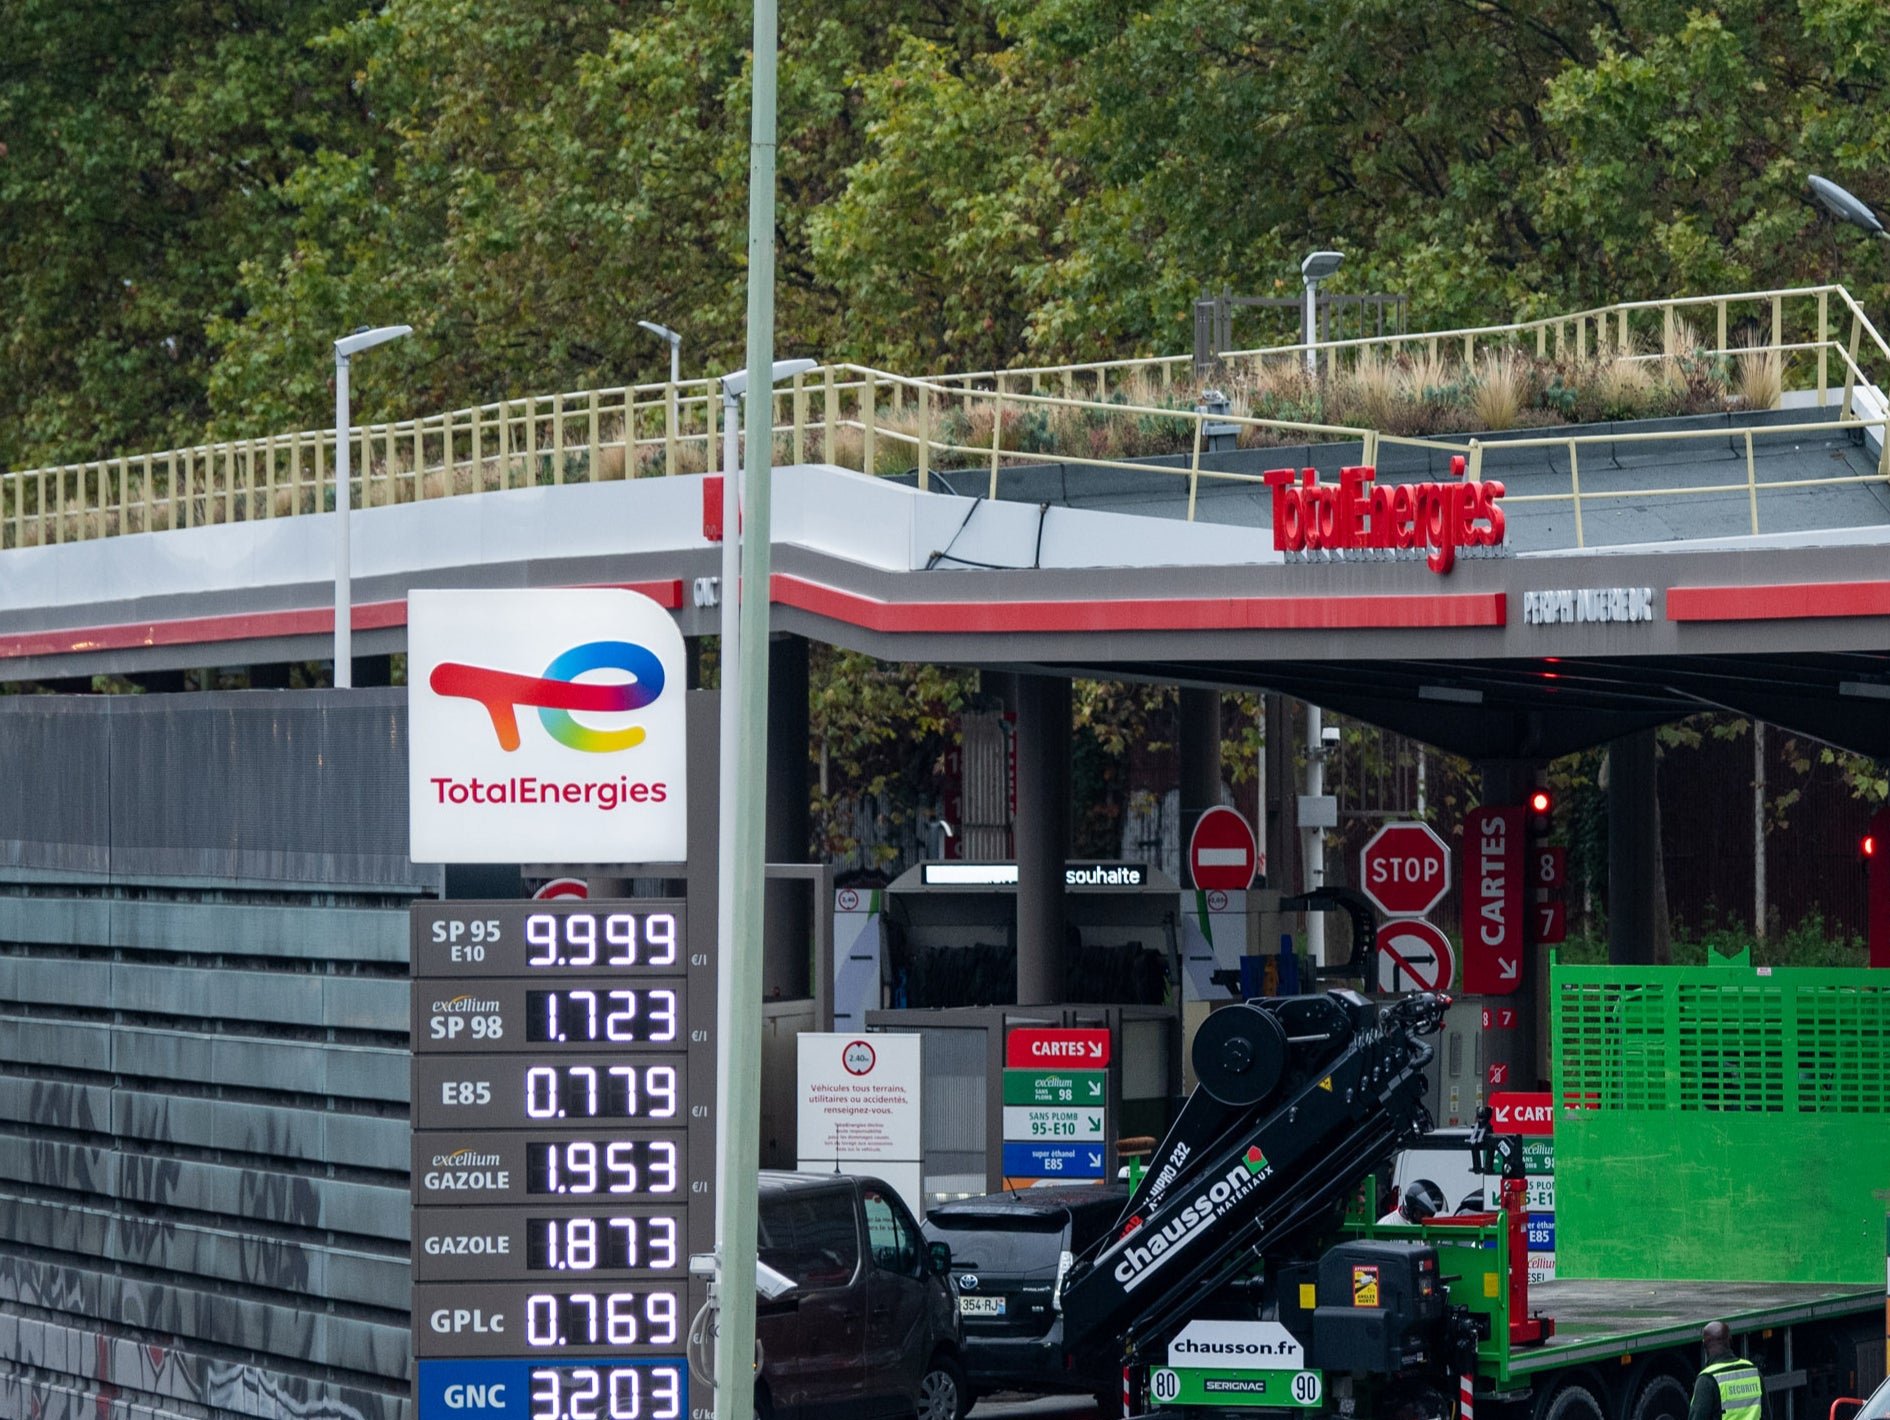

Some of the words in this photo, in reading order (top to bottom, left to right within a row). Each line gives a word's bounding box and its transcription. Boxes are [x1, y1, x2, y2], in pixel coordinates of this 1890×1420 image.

[1263, 455, 1506, 574] TotalEnergies
[430, 776, 667, 810] TotalEnergies
[1066, 866, 1141, 884] souhaite
[1372, 857, 1439, 883] STOP
[1540, 854, 1556, 882] 8
[1481, 816, 1506, 946] CARTES
[432, 920, 464, 943] SP
[470, 920, 501, 943] 95
[1540, 910, 1555, 937] 7
[526, 914, 676, 966] 9.999
[451, 946, 485, 962] E10
[432, 996, 500, 1012] excellium
[548, 990, 676, 1042] 1.723
[1482, 1012, 1489, 1026] 8
[1502, 1011, 1512, 1026] 7
[430, 1016, 465, 1039] SP
[471, 1016, 503, 1039] 98
[1032, 1041, 1085, 1056] CARTES
[526, 1066, 676, 1118] 0.779
[811, 1084, 850, 1093] Véhicules
[852, 1085, 870, 1093] tous
[1035, 1076, 1073, 1087] excellium
[442, 1082, 492, 1104] E85
[809, 1095, 848, 1104] utilitaires
[850, 1096, 861, 1104] ou
[1059, 1089, 1073, 1101] 98
[1029, 1112, 1050, 1121] SANS
[1052, 1113, 1078, 1121] PLOMB
[1514, 1106, 1554, 1122] CART
[1032, 1122, 1075, 1135] 95-E10
[432, 1150, 500, 1167] excellium
[1032, 1150, 1050, 1158] super
[1051, 1149, 1075, 1157] éthanol
[1044, 1158, 1063, 1170] E85
[1169, 1141, 1191, 1168] 232
[548, 1142, 677, 1194] 1.953
[424, 1171, 510, 1191] GAZOLE
[1216, 1165, 1274, 1216] MATÉRIAUX
[1114, 1164, 1251, 1283] chausson
[424, 1236, 510, 1255] GAZOLE
[548, 1218, 677, 1270] 1.873
[1529, 1230, 1550, 1243] E85
[430, 1310, 505, 1333] GPLc
[527, 1293, 677, 1346] 0.769
[1174, 1338, 1298, 1357] chausson.fr
[1156, 1371, 1176, 1398] 80
[1206, 1380, 1265, 1391] SERIGNAC
[1296, 1373, 1316, 1401] 90
[444, 1385, 506, 1409] GNC
